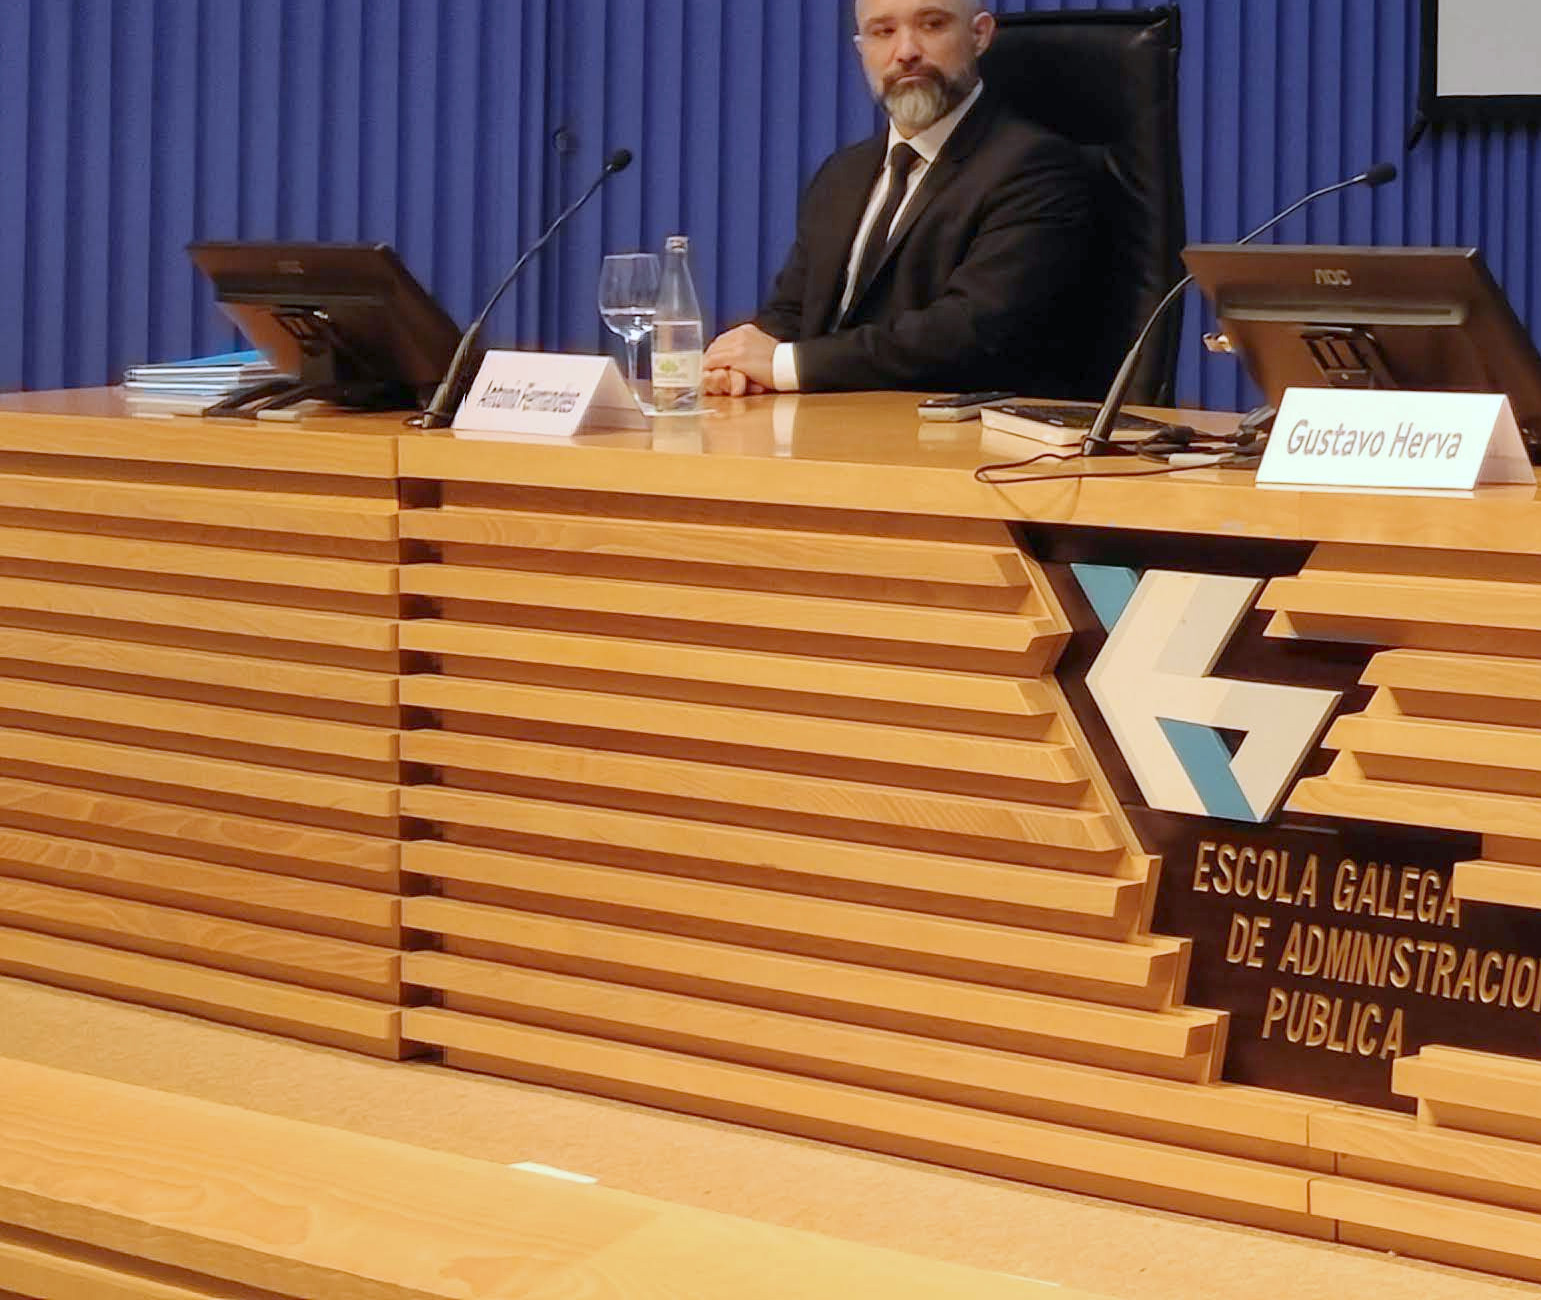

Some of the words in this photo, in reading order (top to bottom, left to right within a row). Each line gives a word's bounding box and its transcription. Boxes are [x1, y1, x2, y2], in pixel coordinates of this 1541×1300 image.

[1316, 269, 1351, 286] AOC
[1287, 419, 1384, 458] Gustavo
[1390, 423, 1462, 459] Herva
[1194, 841, 1318, 908] ESCOLA
[1333, 859, 1462, 928] GALEGA
[1226, 913, 1272, 968] DE
[1262, 987, 1405, 1058] PUBLICA
